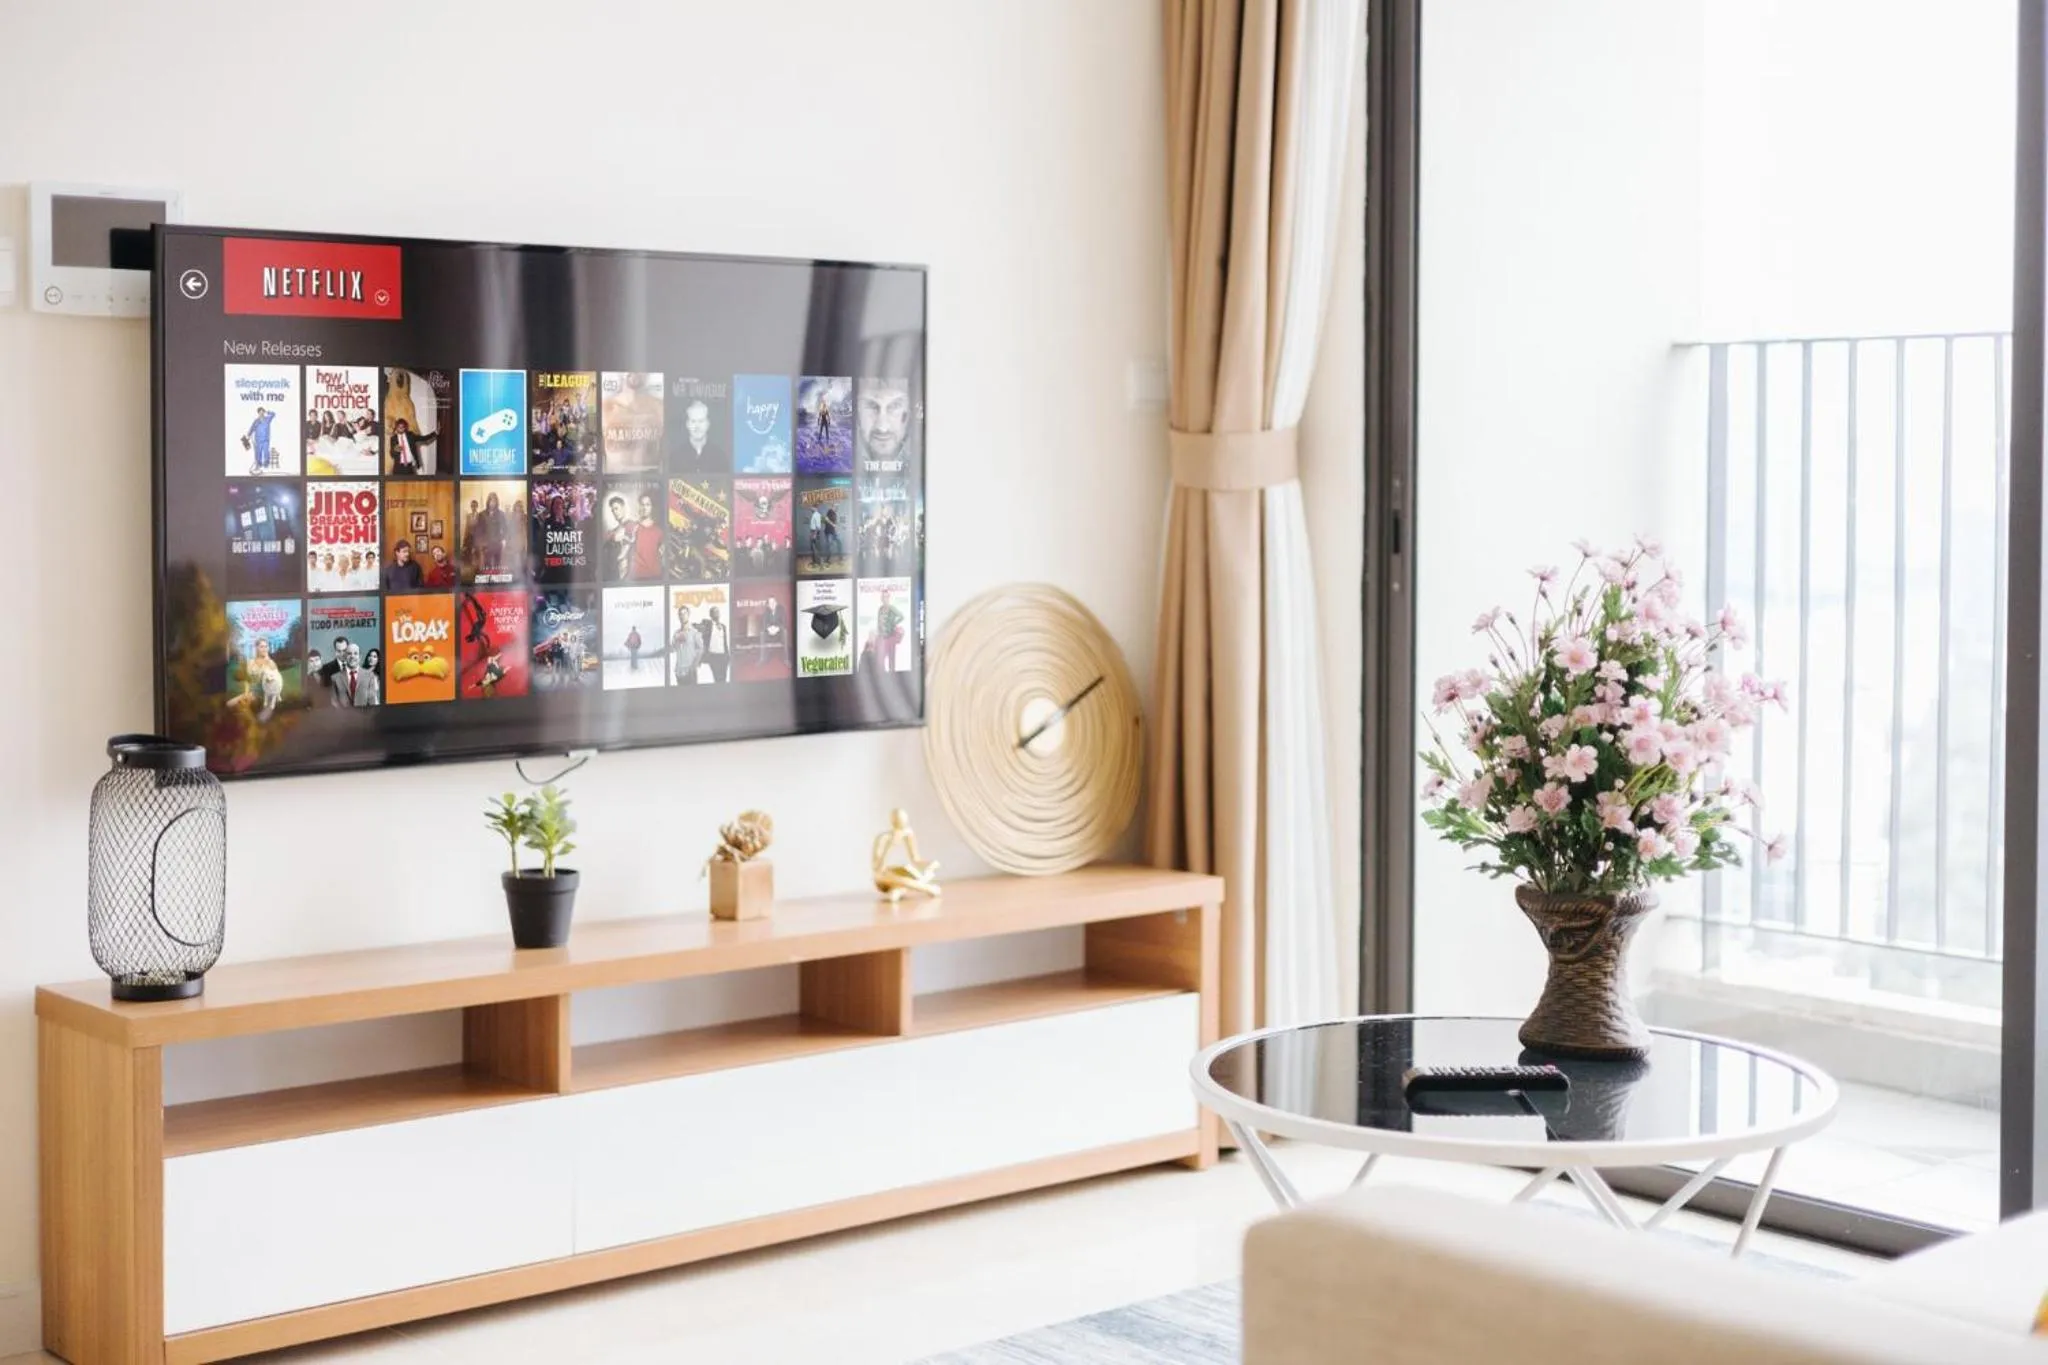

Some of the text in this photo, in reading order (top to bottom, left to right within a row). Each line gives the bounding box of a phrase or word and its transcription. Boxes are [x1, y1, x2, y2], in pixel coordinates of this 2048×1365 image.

[263, 267, 363, 300] NETFLIX
[223, 340, 322, 357] New Releases
[235, 378, 290, 389] sleepwalk
[316, 369, 343, 384] how
[546, 374, 591, 388] LEAGUE
[240, 390, 285, 401] with me
[326, 382, 369, 395] met your
[314, 394, 371, 409] mother
[746, 396, 780, 421] happy
[309, 490, 378, 516] JIRO
[310, 515, 377, 526] DREAMS OF
[310, 524, 377, 544] SUSHI
[546, 530, 584, 543] SMART
[546, 543, 584, 555] LAUGHS
[332, 617, 377, 629] MARGARET
[391, 619, 451, 643] LORAX
